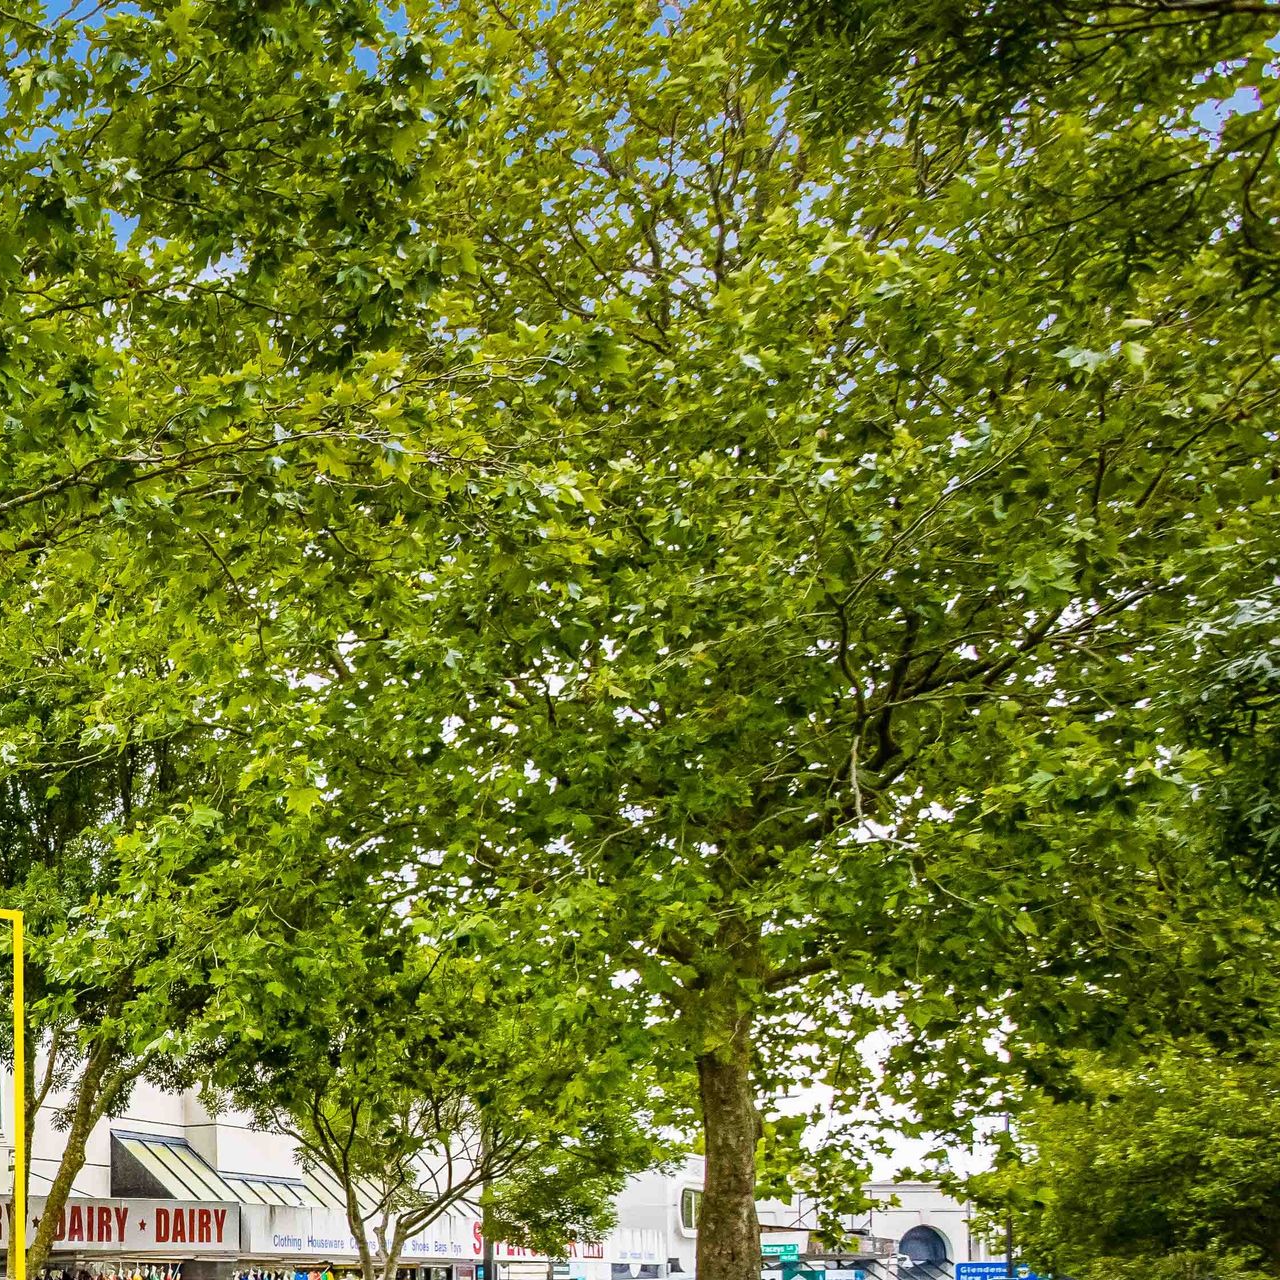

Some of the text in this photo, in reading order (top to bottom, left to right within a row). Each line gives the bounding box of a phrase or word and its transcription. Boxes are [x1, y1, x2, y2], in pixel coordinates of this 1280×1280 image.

[155, 1207, 228, 1243] DAIRY
[273, 1234, 302, 1250] Clothing
[307, 1235, 345, 1249] Houseware
[411, 1240, 429, 1252] Shoes
[434, 1240, 447, 1255] Bags
